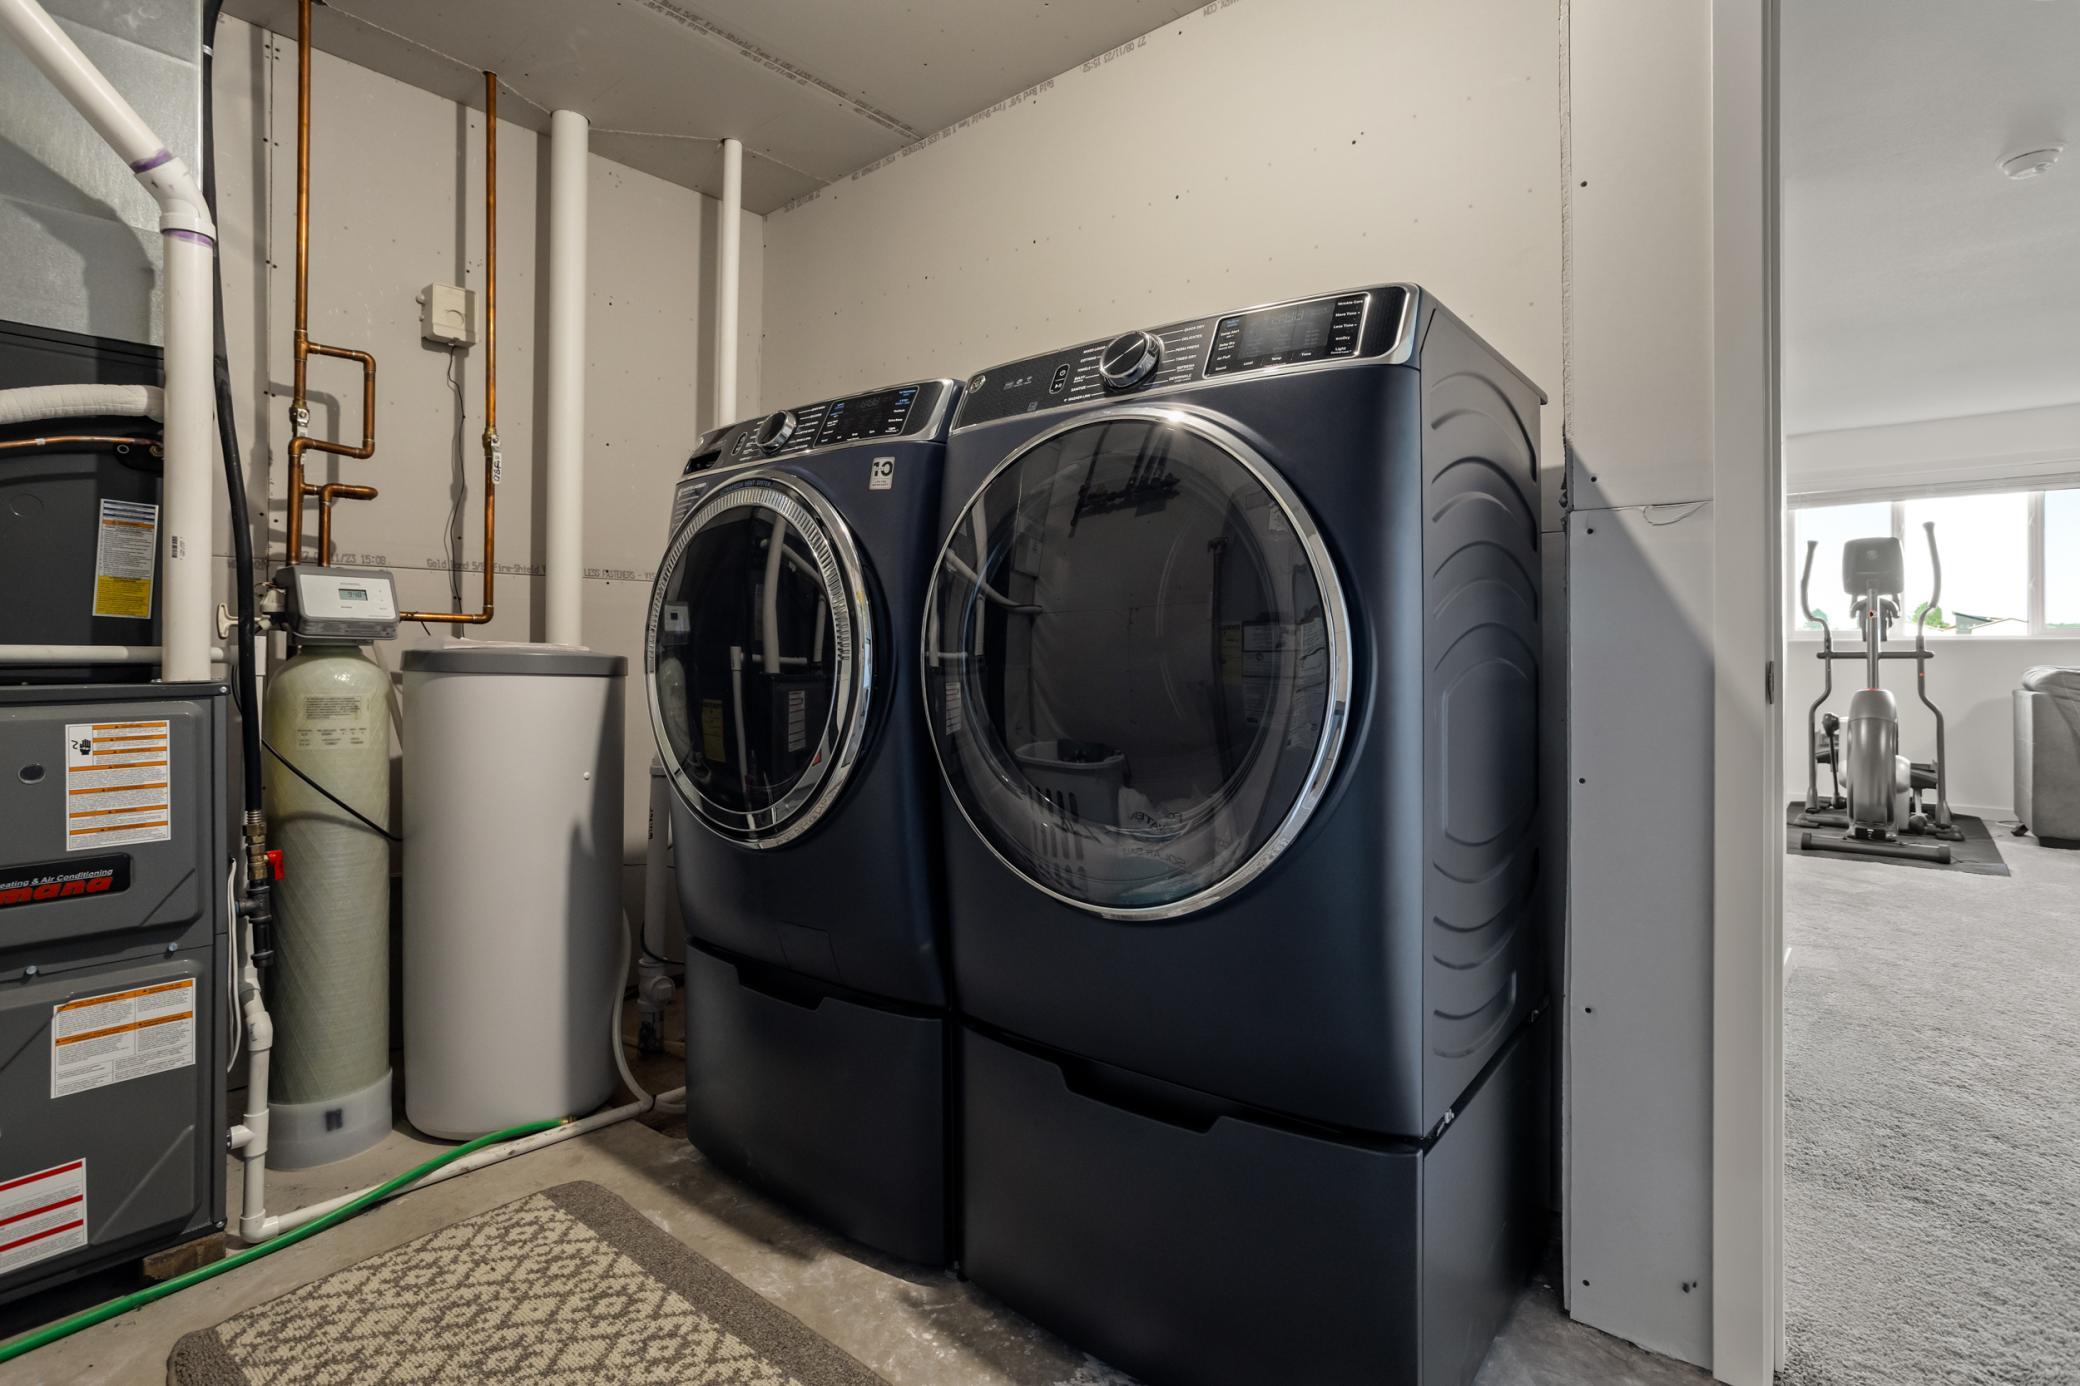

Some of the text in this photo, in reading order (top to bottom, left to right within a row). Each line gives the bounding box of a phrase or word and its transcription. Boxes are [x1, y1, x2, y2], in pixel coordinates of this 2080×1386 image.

[874, 461, 893, 477] 10
[361, 554, 387, 565] 15:08
[426, 558, 447, 569] Gold
[584, 568, 601, 577] LESS
[31, 878, 39, 886] &
[41, 876, 55, 884] Air
[56, 868, 114, 882] Conditioning
